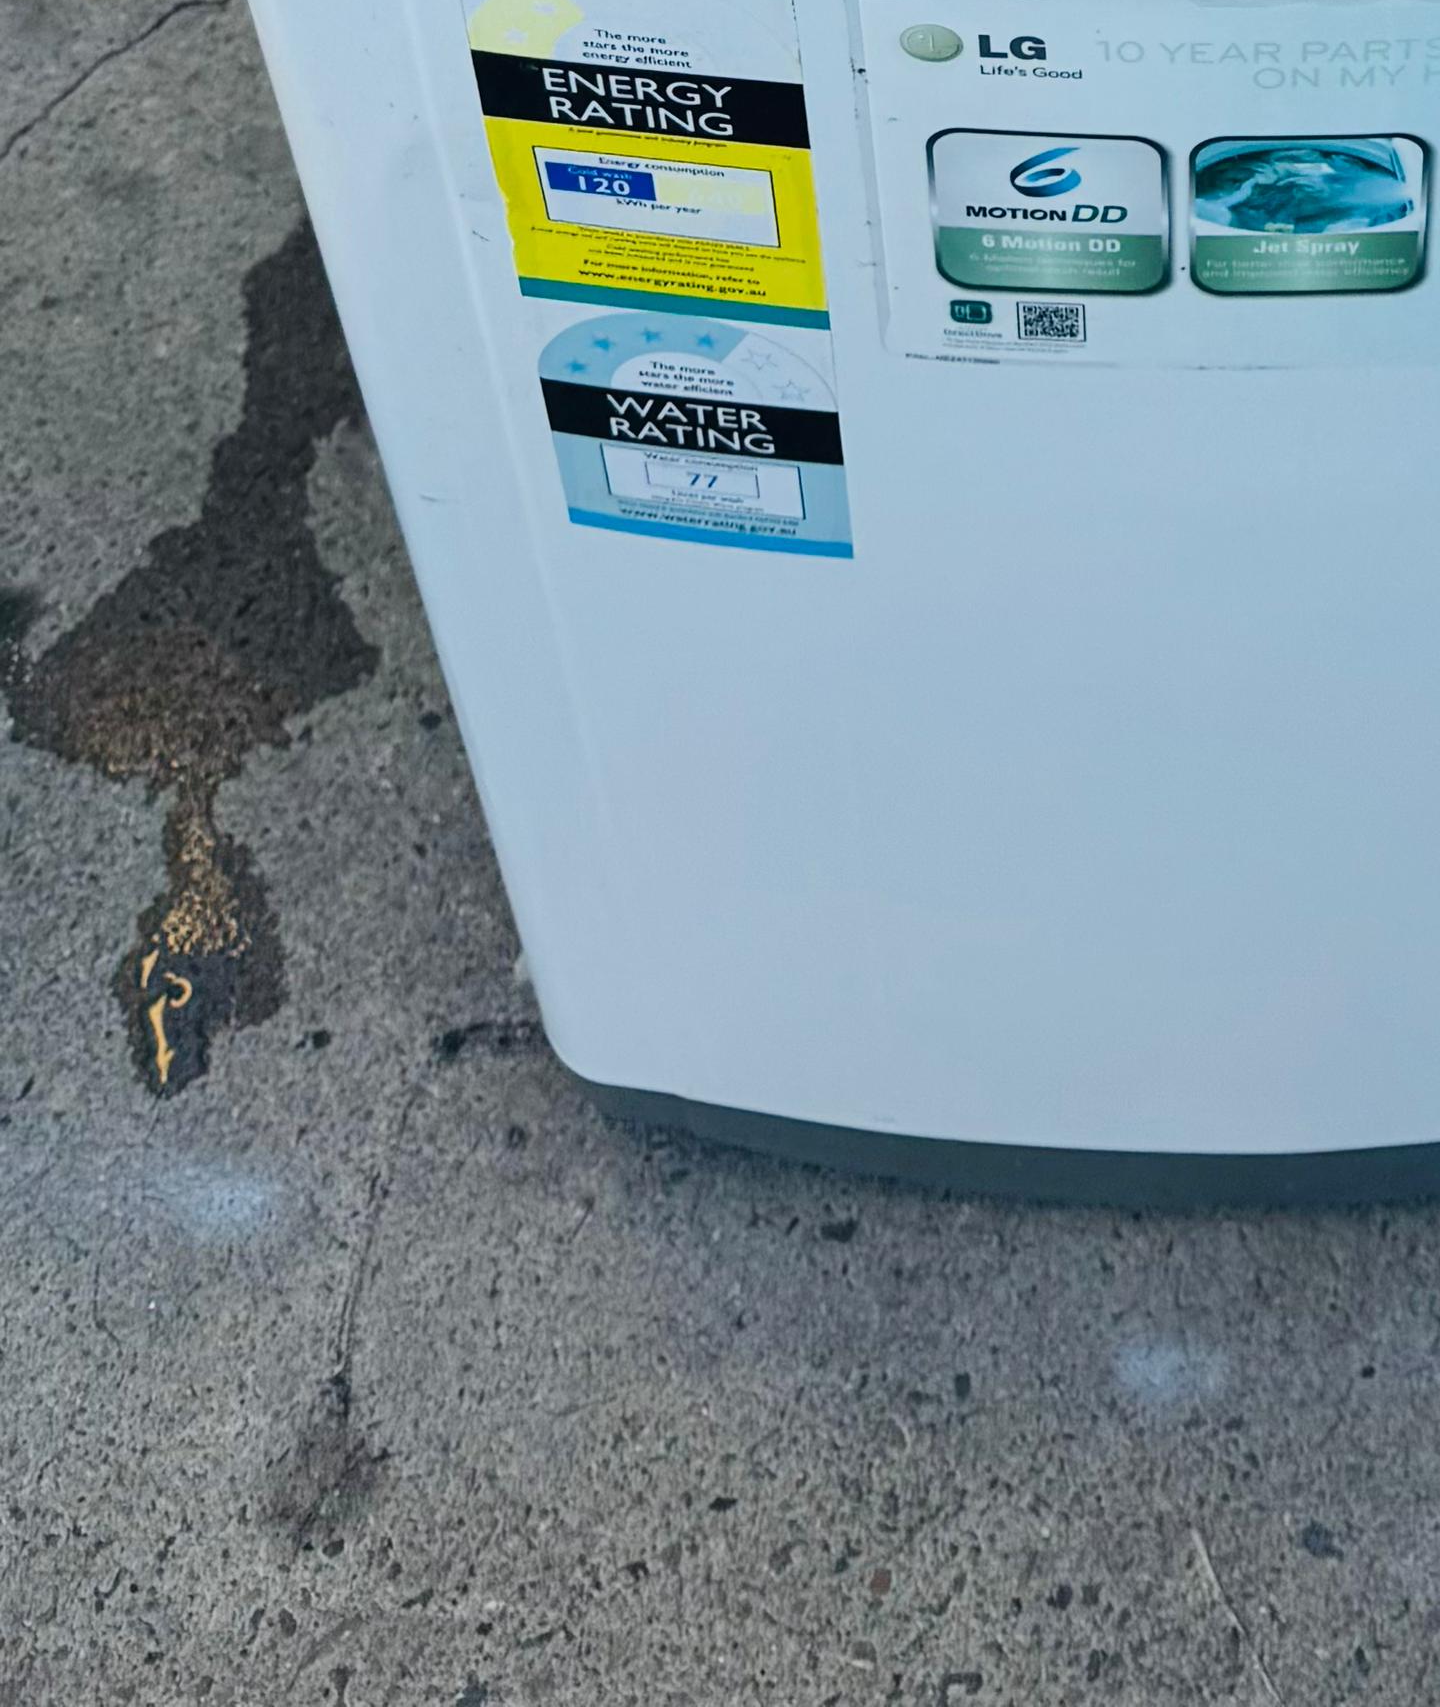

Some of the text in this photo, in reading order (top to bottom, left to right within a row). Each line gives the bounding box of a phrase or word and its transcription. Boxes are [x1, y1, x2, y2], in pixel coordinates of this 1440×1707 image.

[595, 29, 666, 44] The more
[583, 41, 689, 57] stars the more
[978, 34, 1047, 60] LG
[1097, 41, 1143, 64] 10
[1160, 41, 1281, 64] YEAR
[582, 52, 692, 68] energy efficient
[980, 65, 1082, 80] Life's Good
[1254, 66, 1320, 90] ON
[1339, 65, 1407, 88] MY
[542, 68, 732, 108] ENERGY
[549, 97, 733, 136] RATING
[599, 157, 725, 177] Energy consumption
[579, 176, 630, 195] 120
[616, 199, 703, 214] kWh per year
[966, 205, 1128, 223] MOTION DD
[982, 235, 1120, 252] 6 Motion DD
[1253, 239, 1360, 255] Jet Spray
[583, 259, 602, 267] For
[607, 262, 638, 270] more
[716, 274, 744, 284] refer
[579, 270, 766, 297] www.energyrating.gov.au
[650, 361, 715, 375] The more
[639, 370, 734, 386] stars the more
[642, 381, 733, 395] water efficient
[607, 394, 767, 431] WATER
[610, 417, 775, 454] RATING
[686, 472, 718, 488] 77
